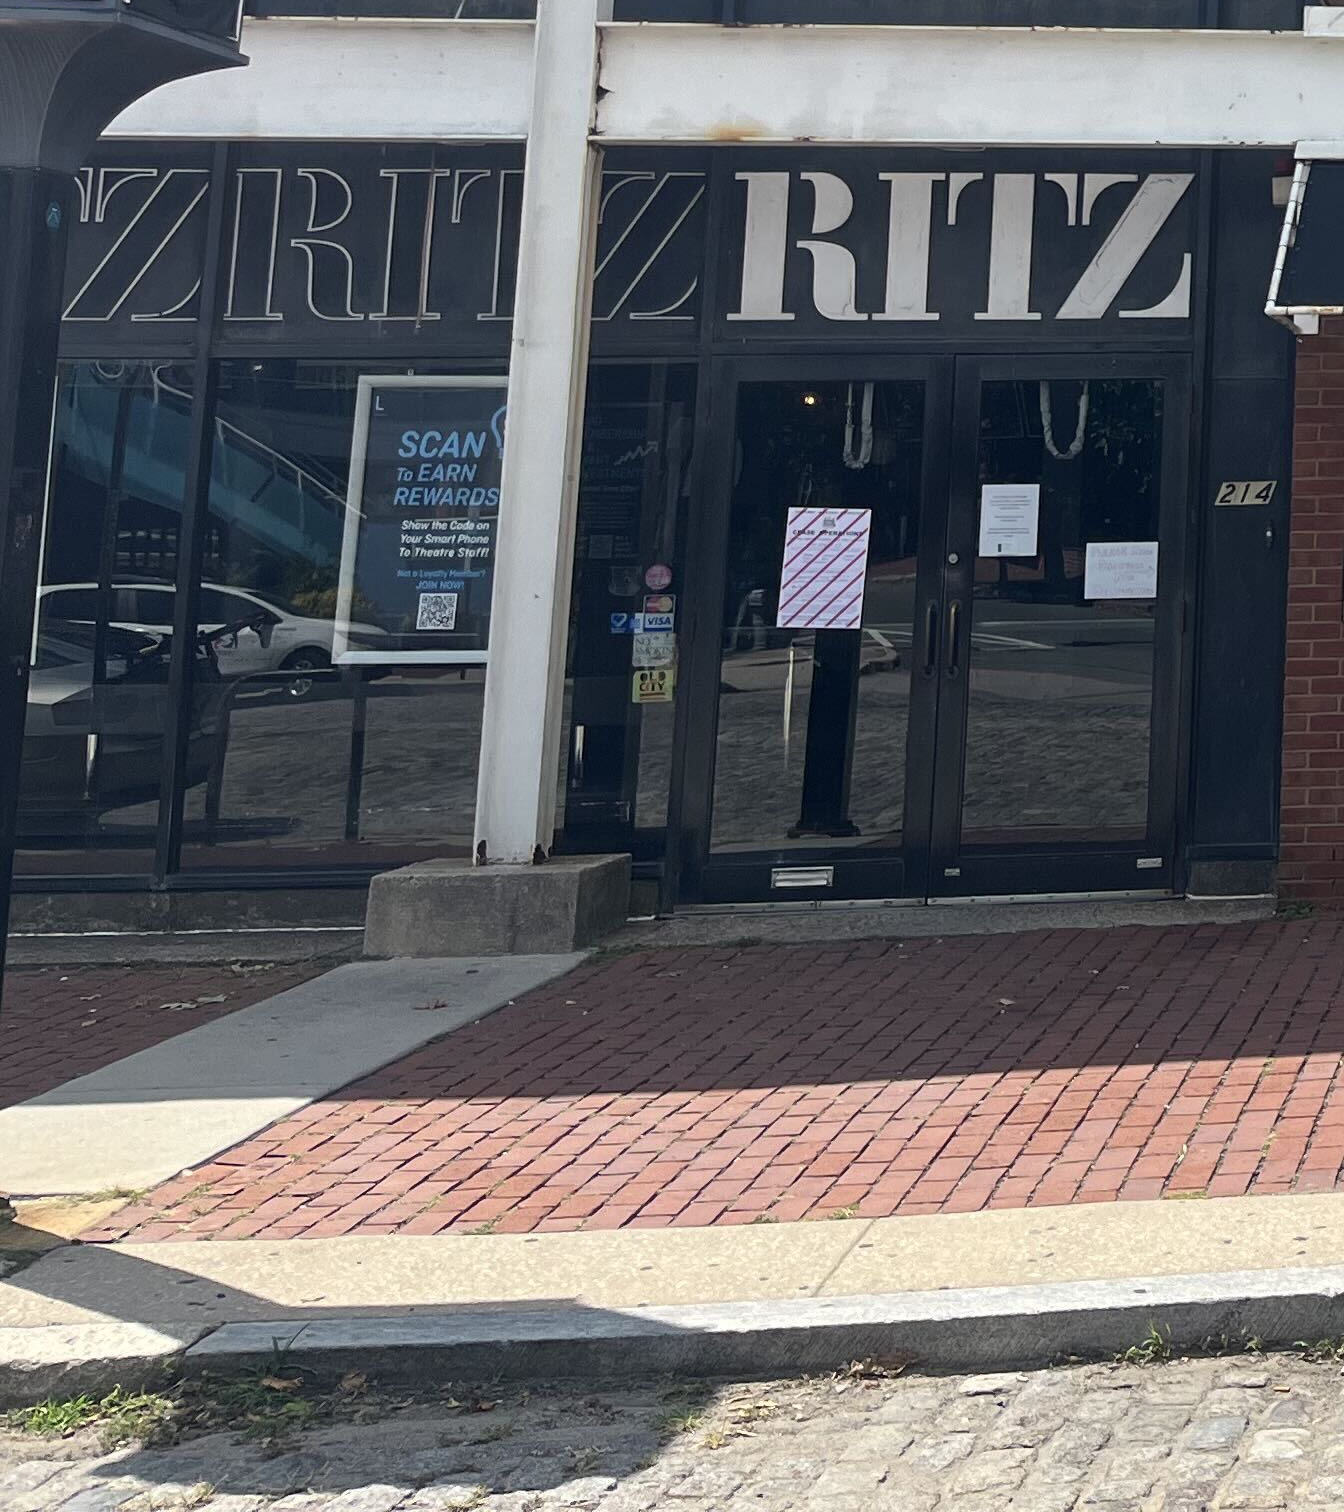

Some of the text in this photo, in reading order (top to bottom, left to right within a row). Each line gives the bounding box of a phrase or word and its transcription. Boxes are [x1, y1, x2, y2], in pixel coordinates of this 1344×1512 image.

[726, 170, 1196, 321] RITZ
[398, 430, 487, 458] SCAN
[417, 463, 478, 482] EARN
[393, 487, 500, 507] REWARDS
[1219, 483, 1274, 504] 214
[401, 520, 490, 530] Show the Code on
[400, 534, 490, 544] Your Smart Phone
[399, 548, 490, 558] To Theatre Staff!
[647, 616, 672, 626] VISA
